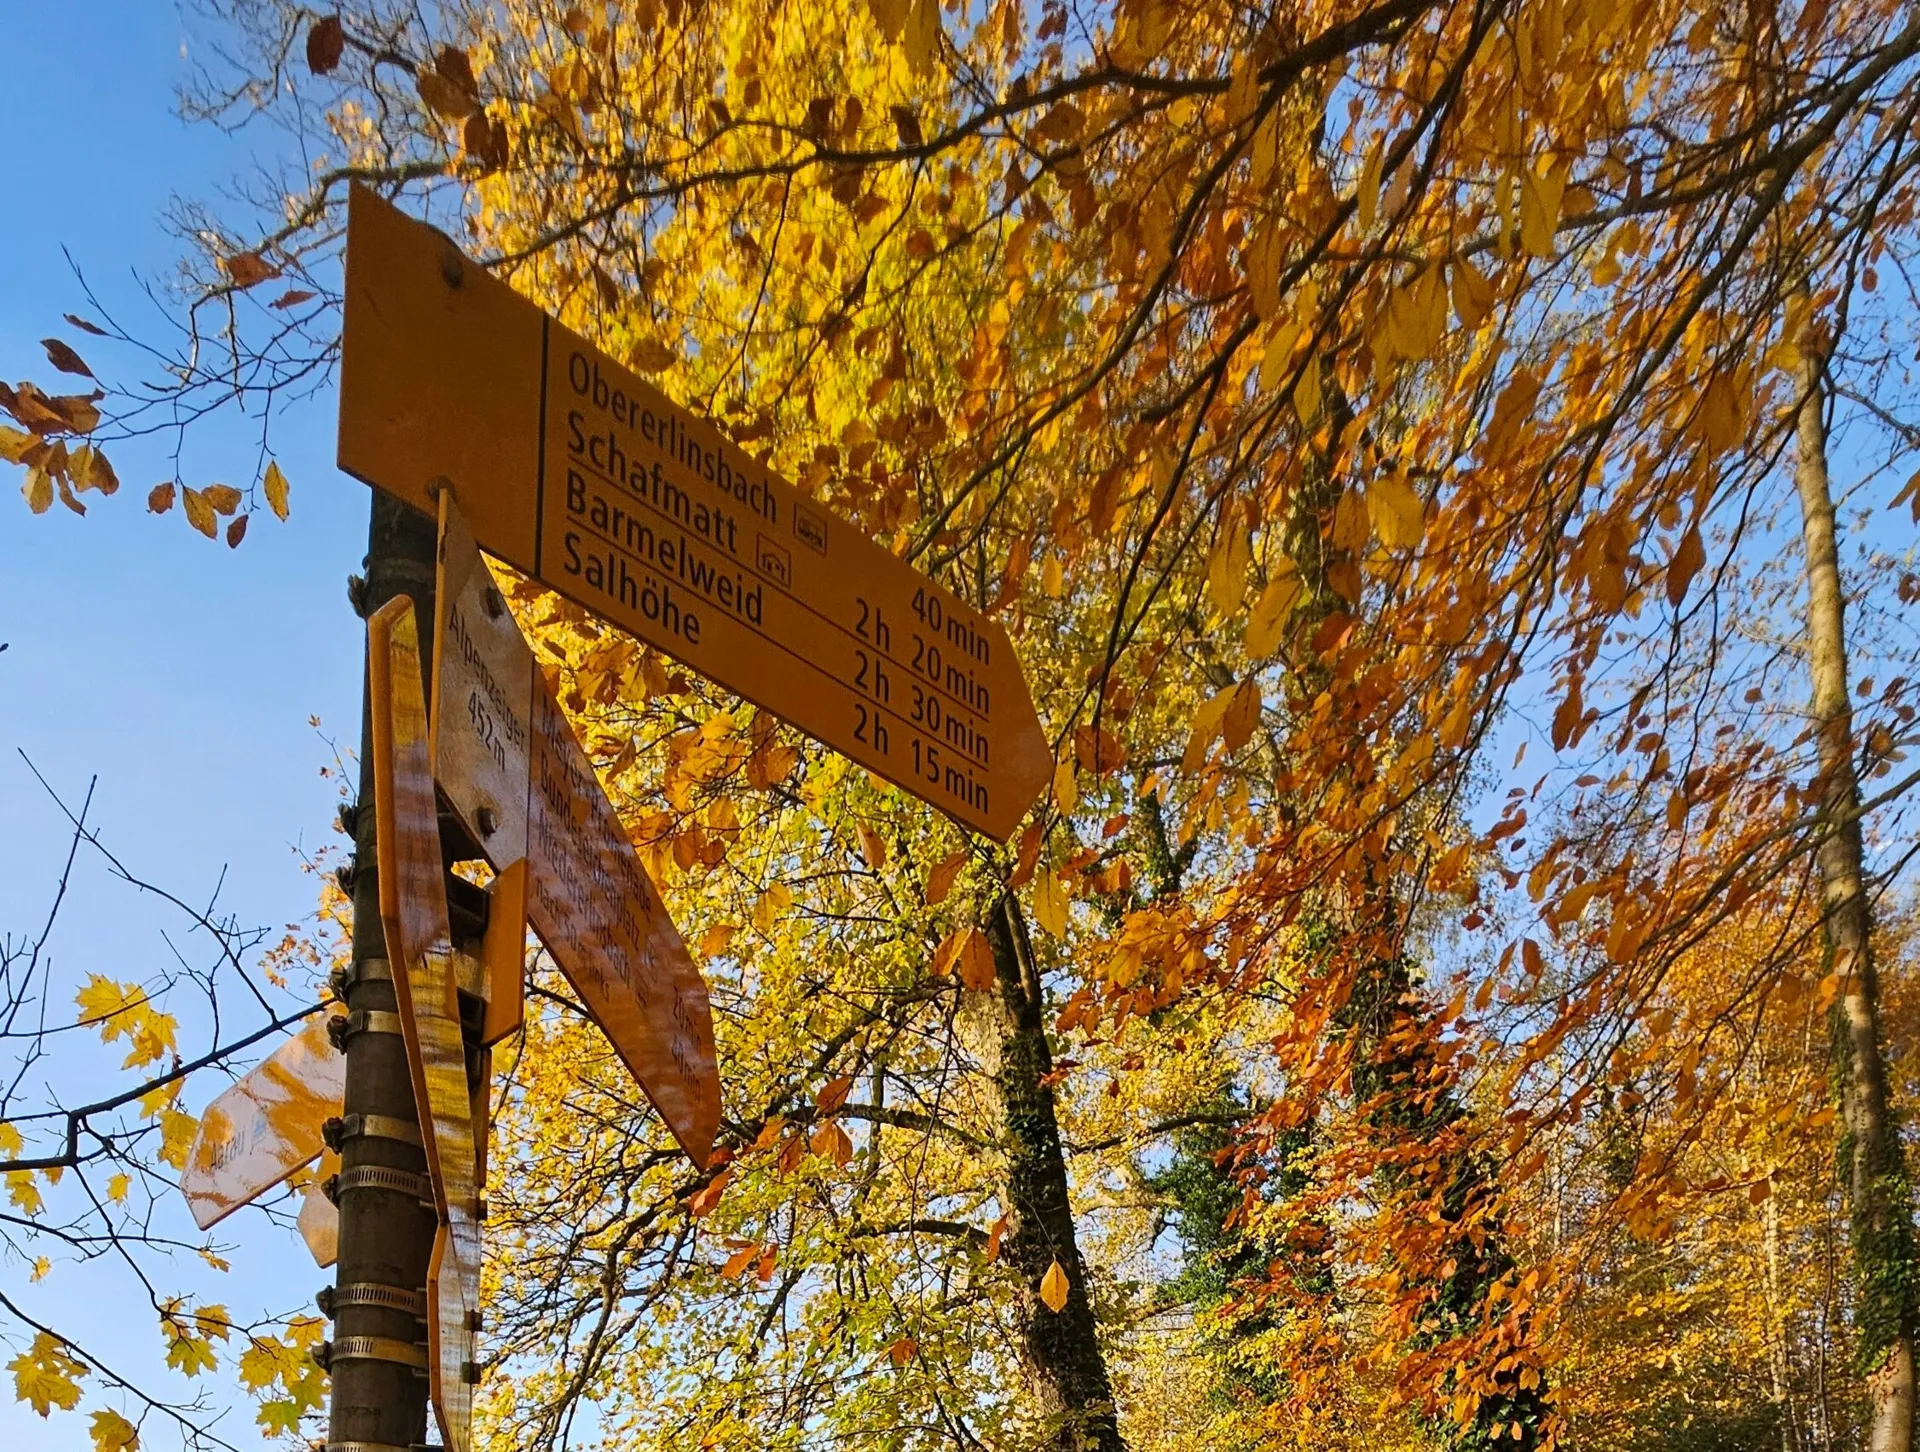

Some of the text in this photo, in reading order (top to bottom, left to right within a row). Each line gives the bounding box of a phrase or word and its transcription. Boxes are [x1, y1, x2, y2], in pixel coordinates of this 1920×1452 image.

[566, 467, 989, 764] Barmelweid 2 h 30 min
[567, 409, 989, 715] Schafmatt 2 h 20 min
[568, 351, 990, 666] Obererlinsbach 40 min
[449, 603, 525, 751] Alpenzeiger
[468, 690, 506, 773] 452 m
[563, 531, 989, 815] Salhöhe 2 h 15 min
